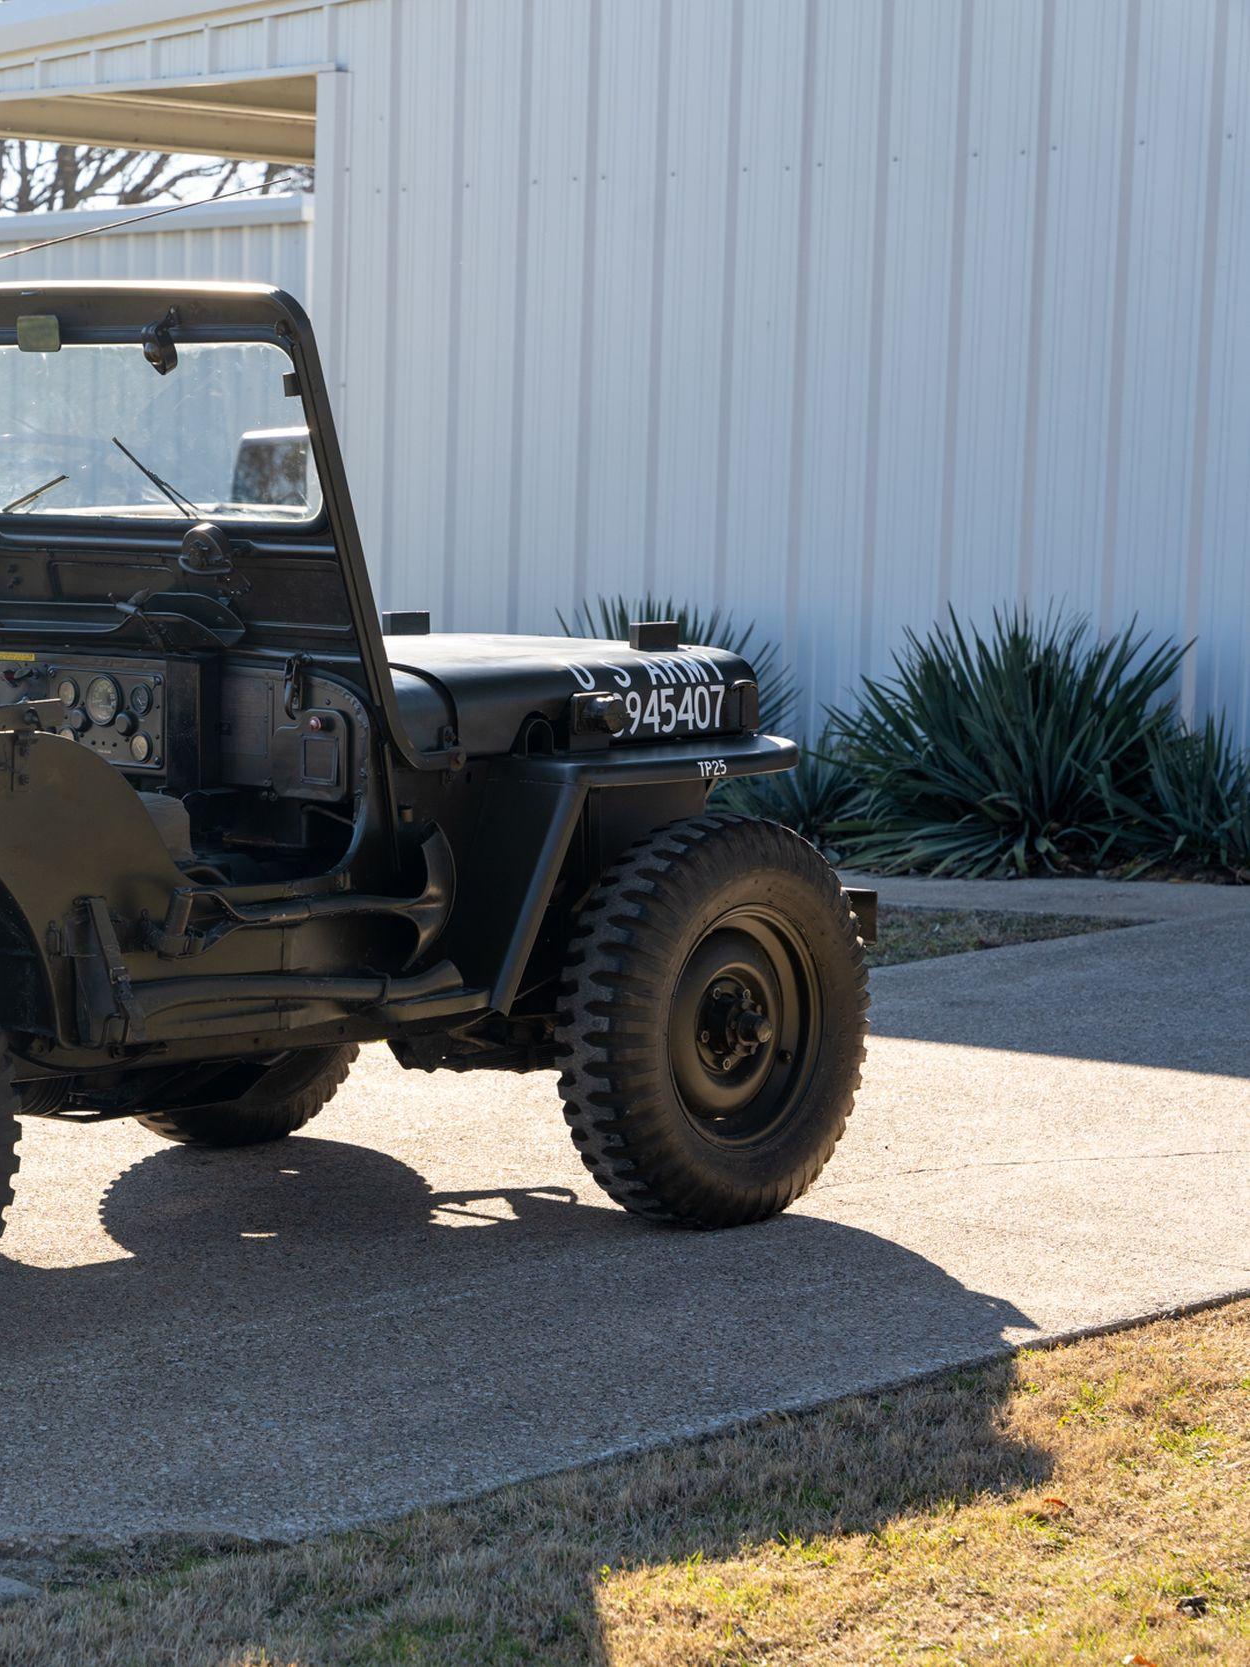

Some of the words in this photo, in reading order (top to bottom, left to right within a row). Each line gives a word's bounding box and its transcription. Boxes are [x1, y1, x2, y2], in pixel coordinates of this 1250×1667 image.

[561, 661, 596, 691] U
[598, 660, 632, 688] S
[635, 654, 724, 686] ARMY
[612, 684, 726, 738] 945407
[697, 759, 727, 778] TP25
